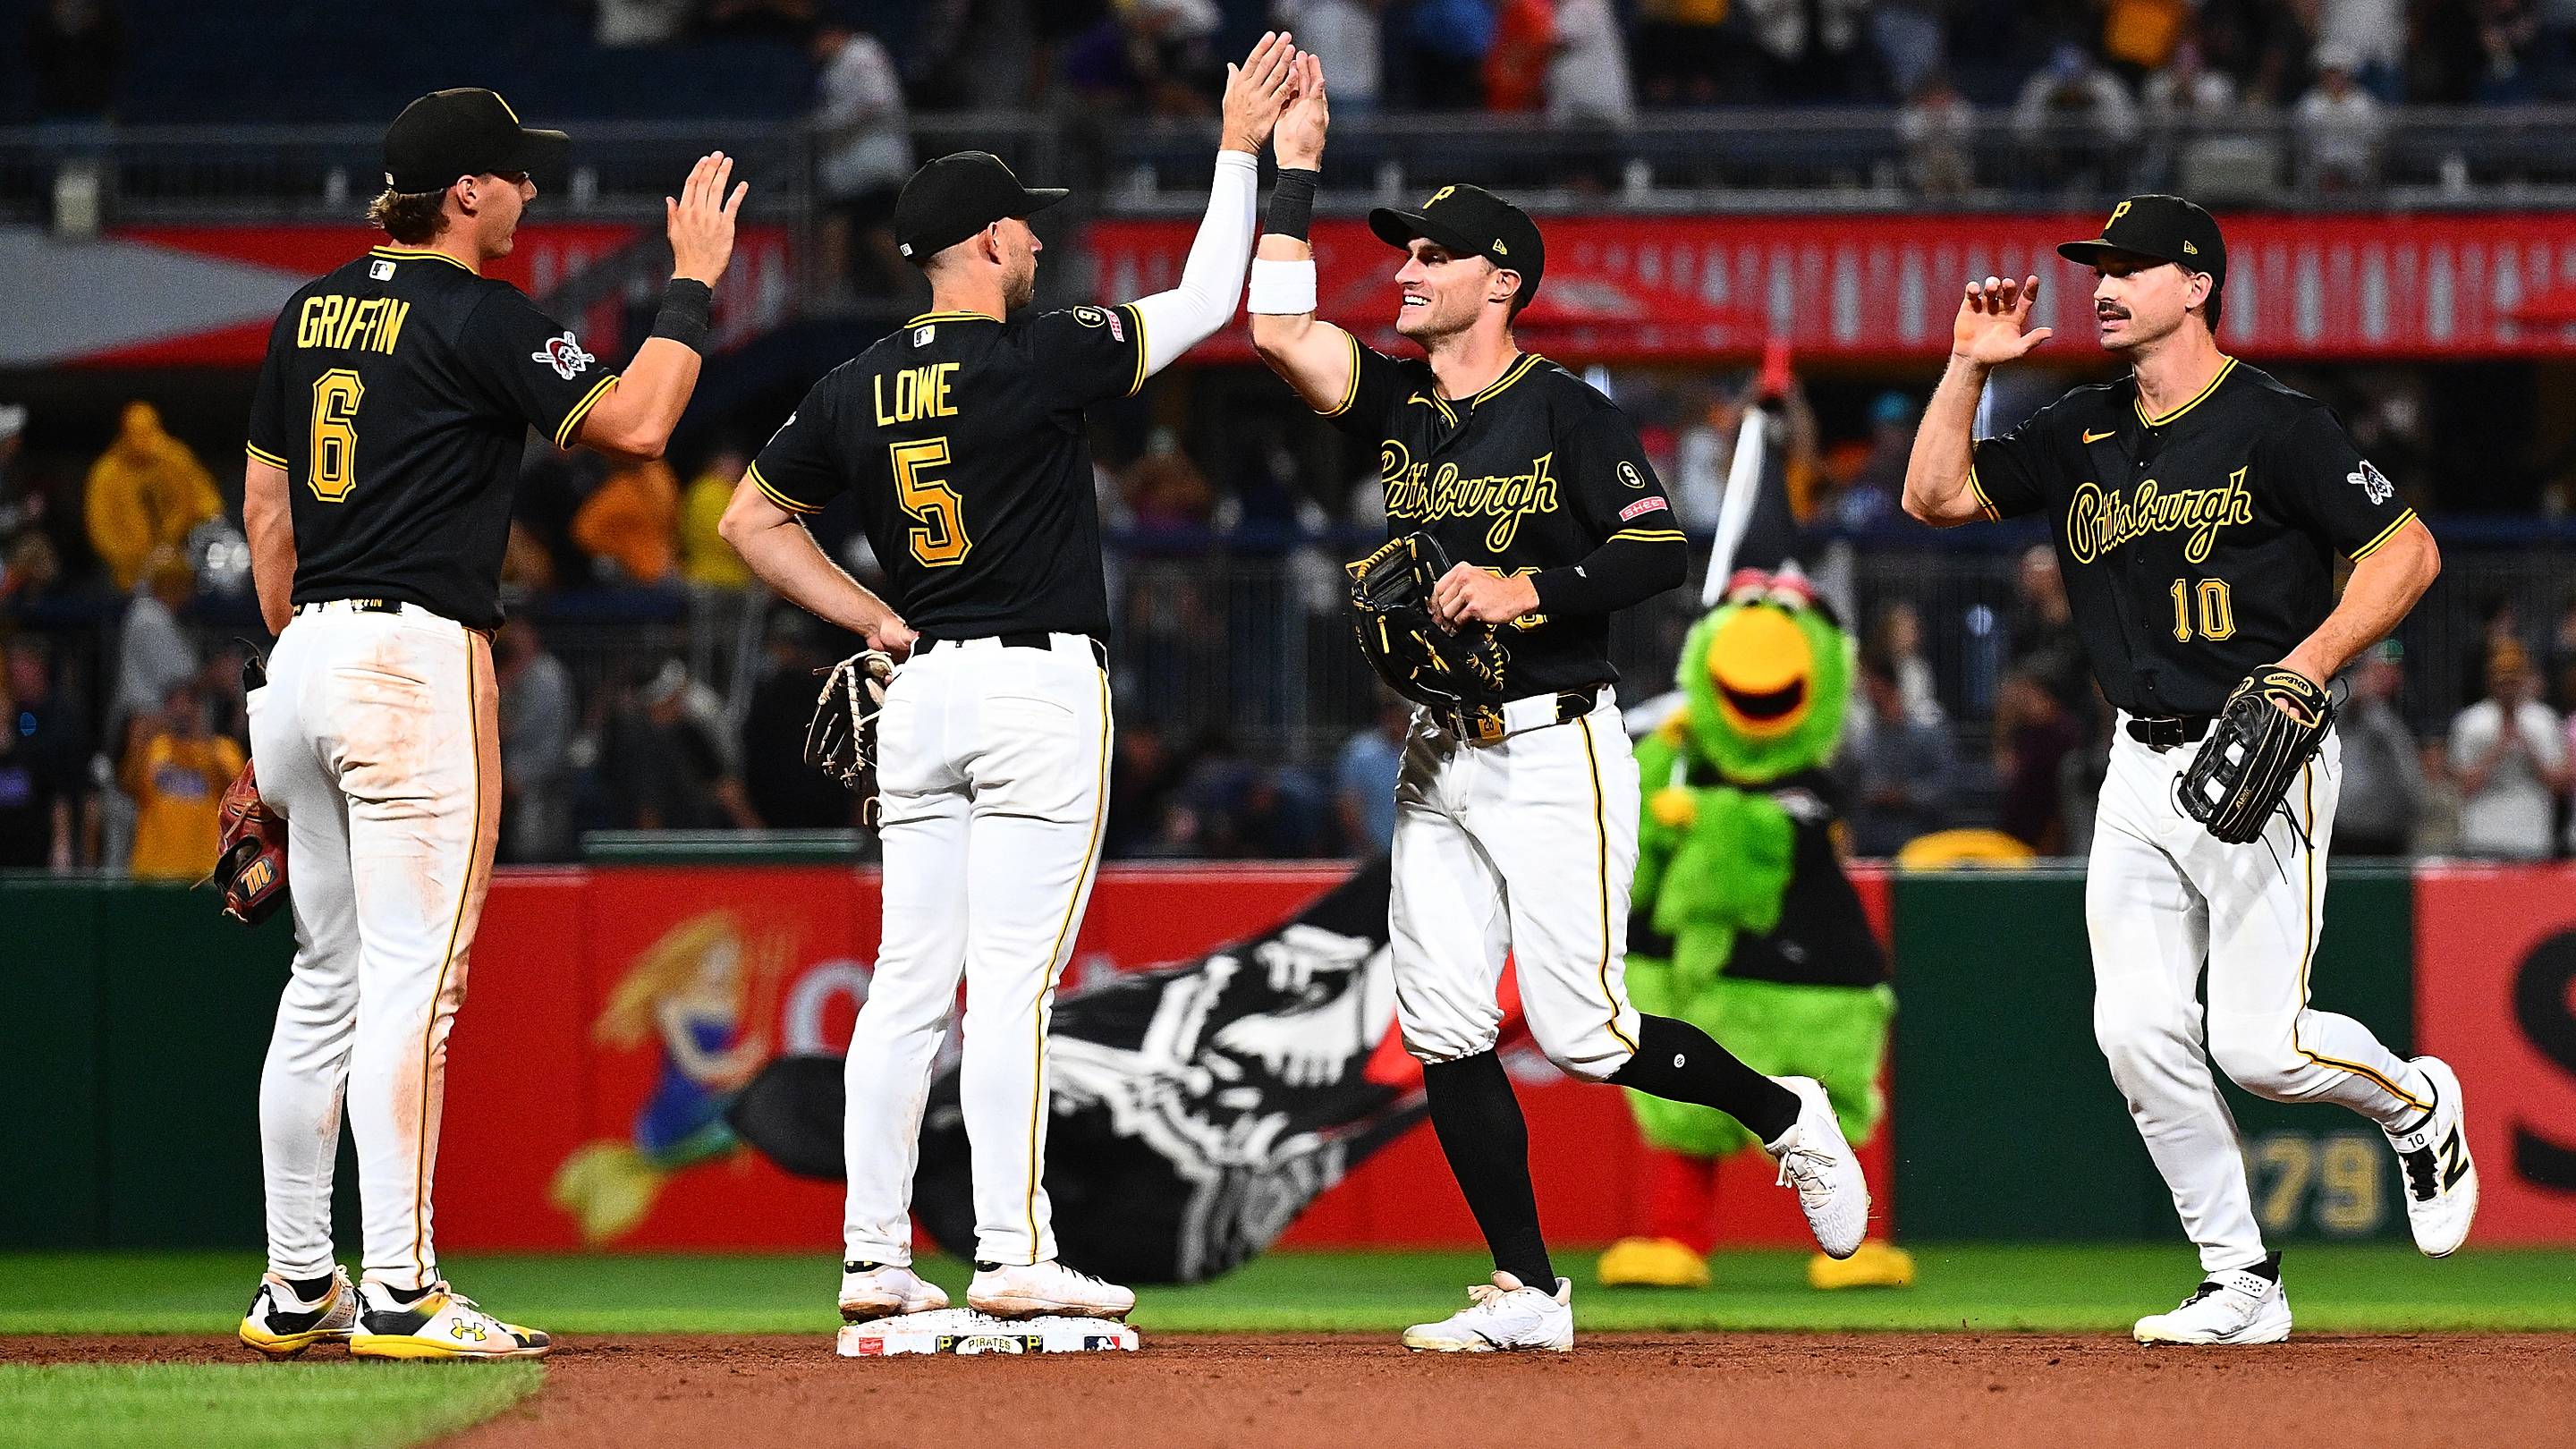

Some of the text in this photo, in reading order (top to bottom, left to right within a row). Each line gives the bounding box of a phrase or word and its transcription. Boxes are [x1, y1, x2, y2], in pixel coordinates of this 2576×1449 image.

[1422, 185, 1455, 209] P
[2105, 200, 2132, 230] P
[297, 294, 411, 355] GRIFFIN
[874, 362, 960, 428] LOWE
[307, 368, 366, 504] 6
[1623, 465, 1640, 485] 9
[889, 436, 973, 568] 5
[2067, 465, 2253, 564] Pittsburgh
[2170, 578, 2236, 643] 10
[2271, 675, 2310, 694] Wilson
[1483, 717, 1495, 733] 28
[2408, 1133, 2425, 1148] 10
[939, 1335, 1040, 1351] P PIRATES P
